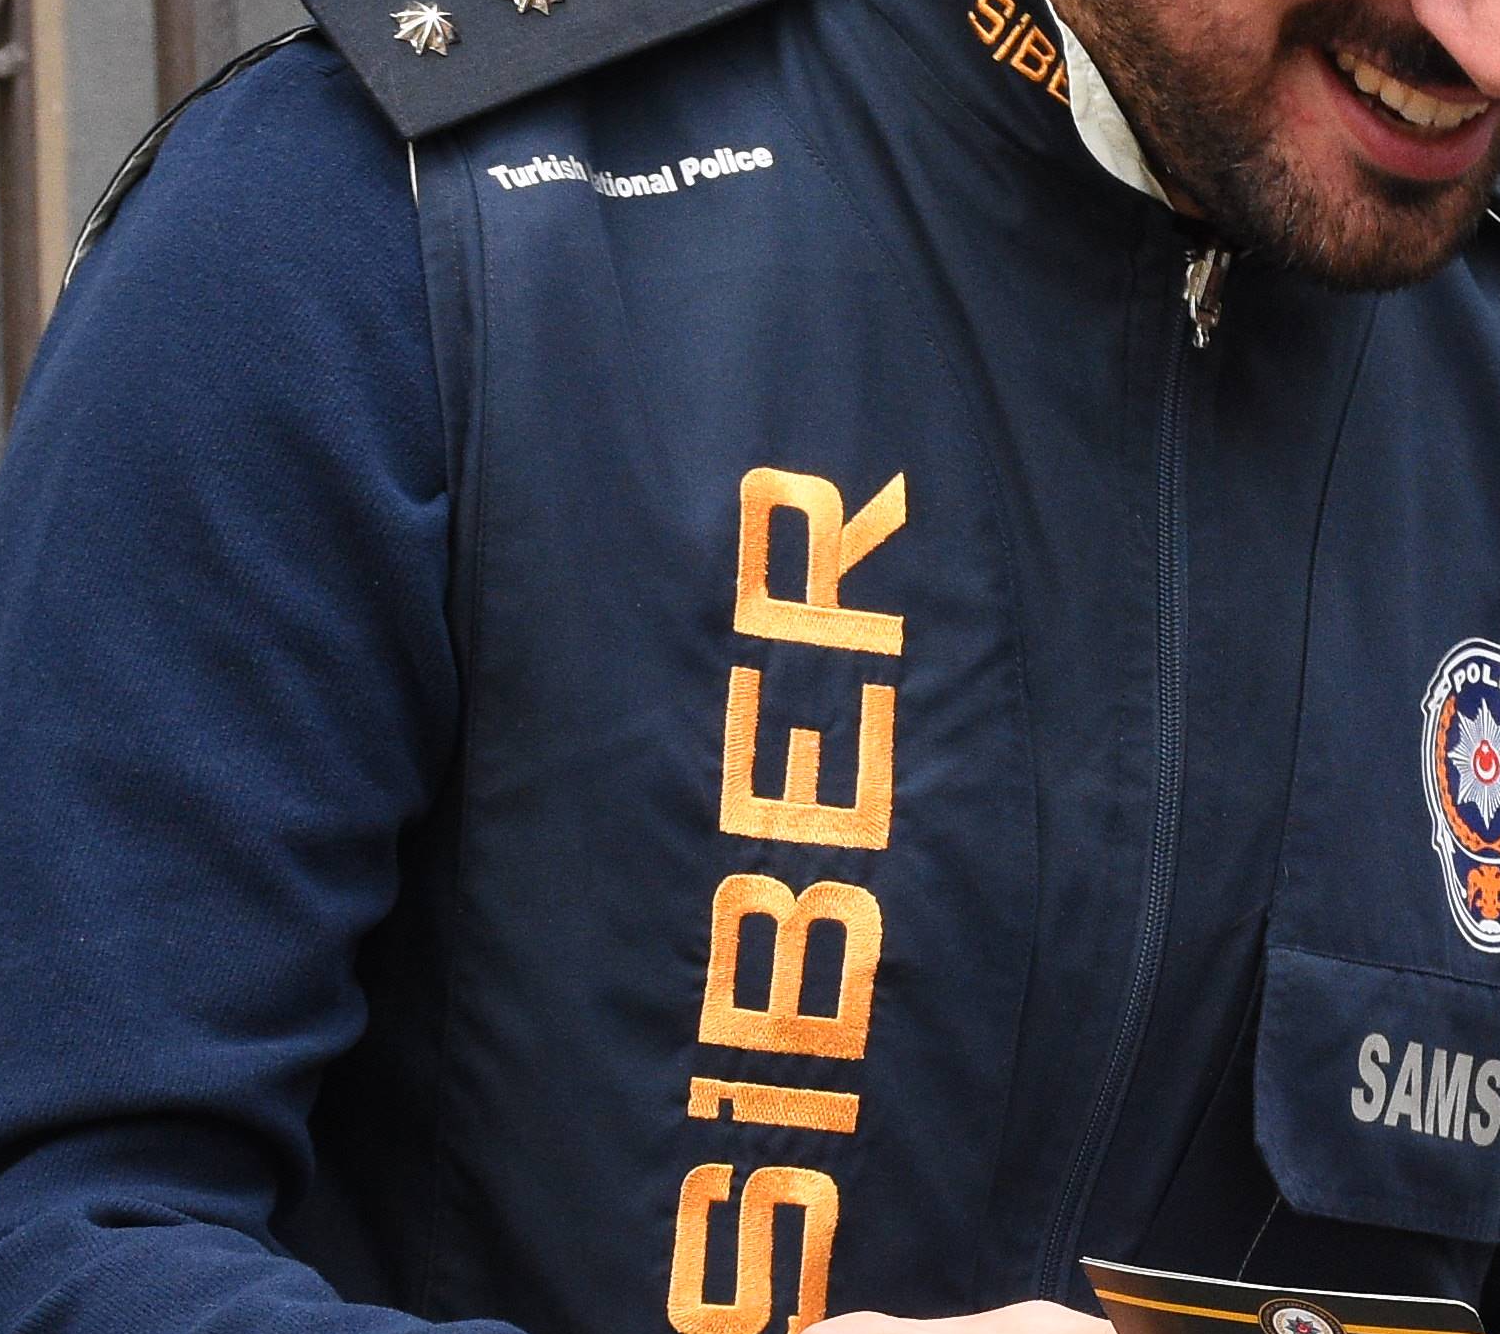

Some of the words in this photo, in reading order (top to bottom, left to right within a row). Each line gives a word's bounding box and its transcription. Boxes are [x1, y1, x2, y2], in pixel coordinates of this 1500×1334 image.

[487, 154, 589, 190] Turkish
[589, 164, 678, 198] ational
[679, 146, 774, 187] Police
